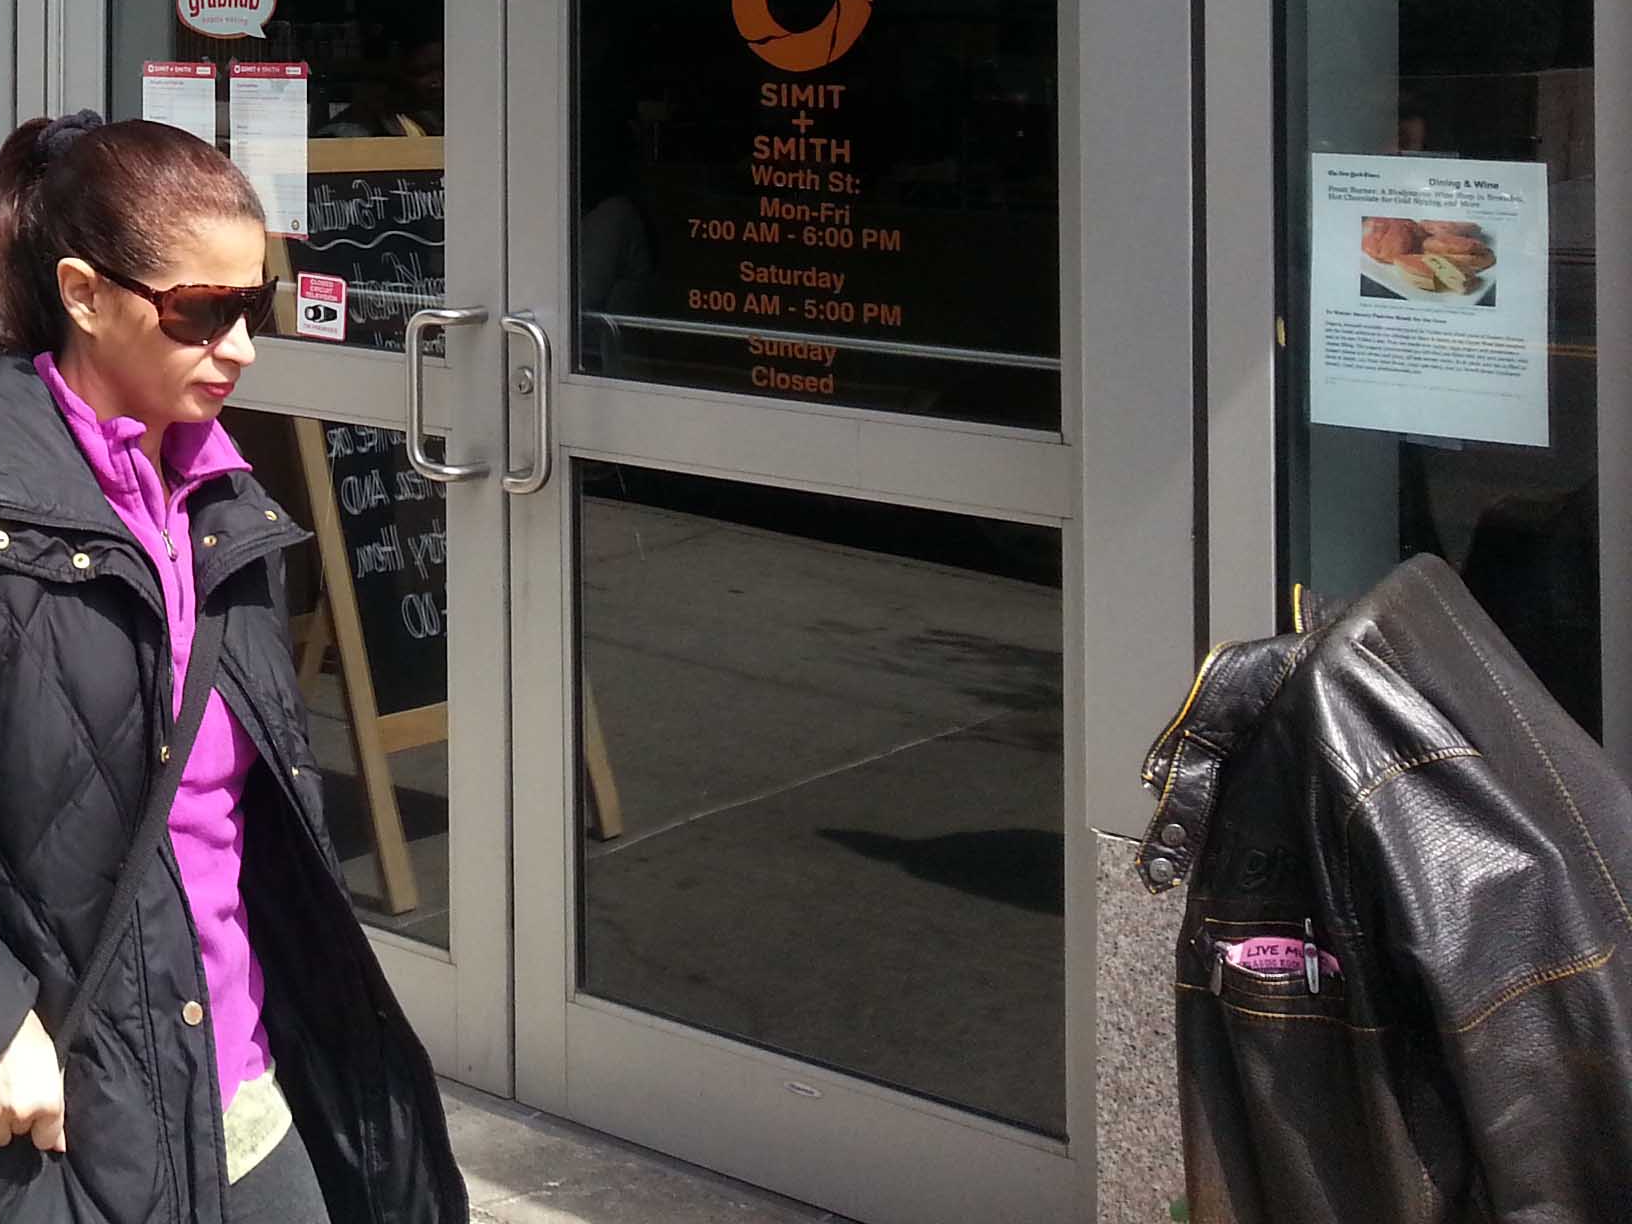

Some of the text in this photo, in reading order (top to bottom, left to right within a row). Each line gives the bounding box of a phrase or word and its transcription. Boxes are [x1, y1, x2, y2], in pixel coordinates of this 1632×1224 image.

[760, 83, 846, 109] SIMIT
[753, 135, 851, 164] SMITH
[751, 164, 861, 194] Worth St:
[1429, 178, 1500, 190] Dining & Wine
[760, 196, 851, 225] Mon-Fri
[687, 218, 736, 240] 7:00
[743, 222, 780, 244] AM
[803, 226, 853, 249] 6:00
[862, 229, 901, 251] PM
[739, 261, 845, 295] Saturday
[688, 289, 736, 313] 8:00
[743, 293, 780, 316] AM
[804, 299, 854, 323] 5:00
[863, 303, 902, 326] PM
[747, 333, 837, 367] Sunday
[751, 366, 835, 395] Closed
[1247, 945, 1279, 957] LIVE
